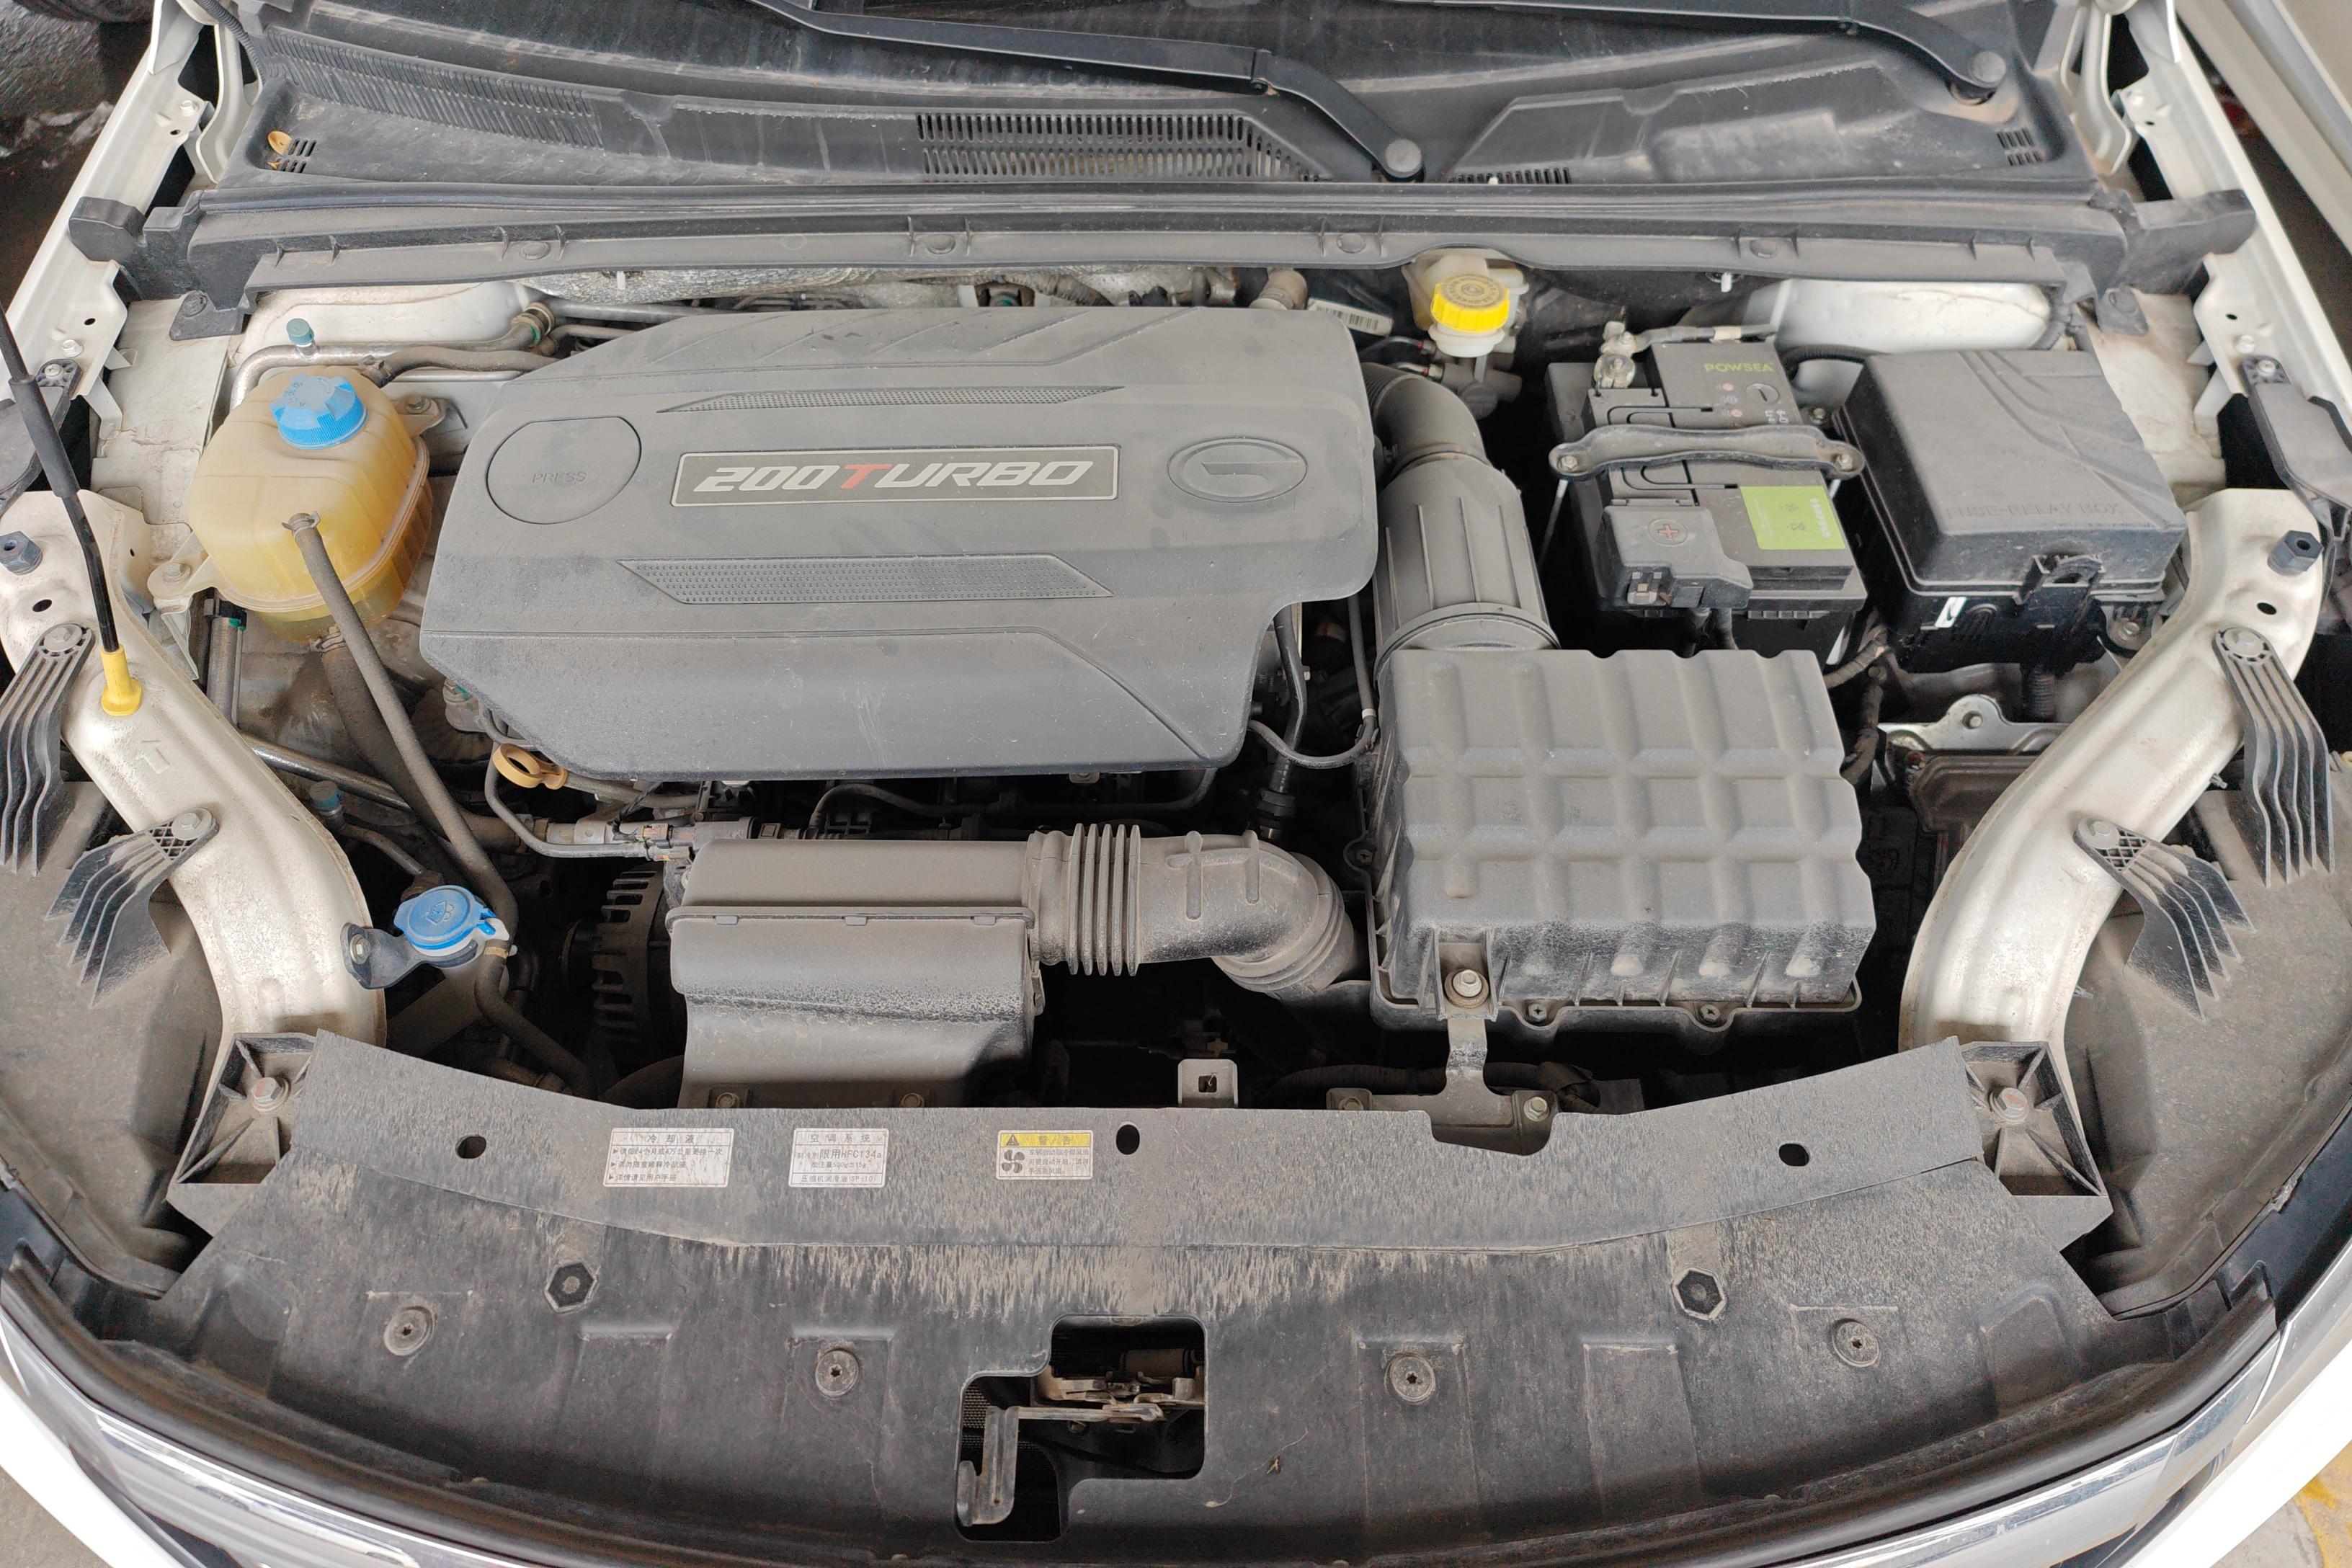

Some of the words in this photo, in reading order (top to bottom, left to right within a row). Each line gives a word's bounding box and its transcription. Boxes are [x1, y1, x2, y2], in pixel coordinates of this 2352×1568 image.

[1703, 362, 1774, 373] POWSEA
[532, 471, 587, 484] PRESS
[2079, 502, 2121, 514] BOX
[646, 1134, 695, 1144] 冷却液
[810, 1133, 871, 1143] 空调系统
[1038, 1136, 1072, 1145] 警告
